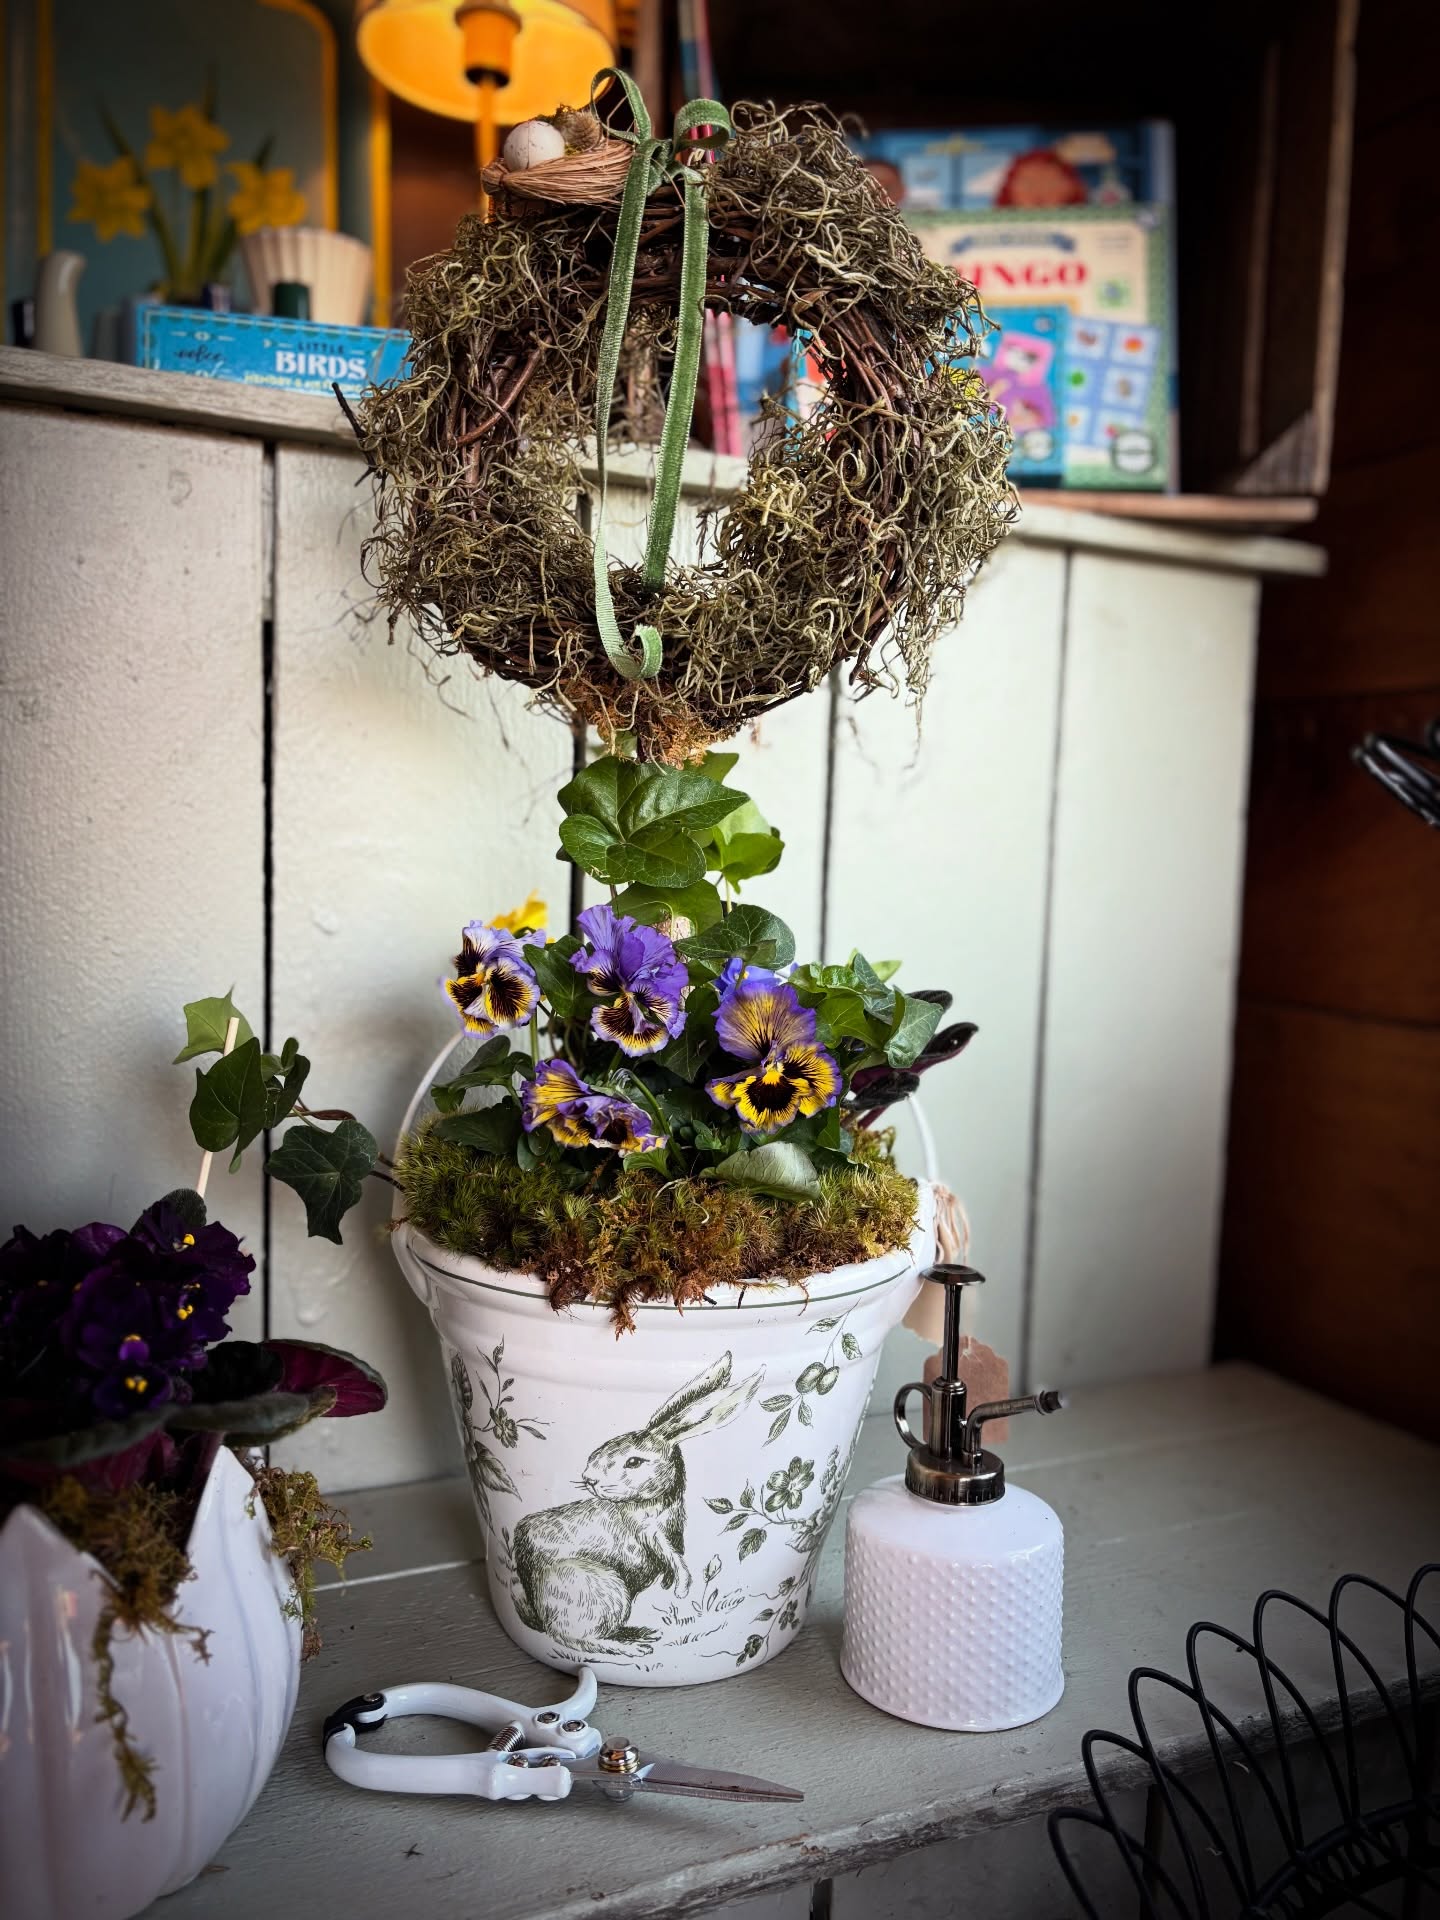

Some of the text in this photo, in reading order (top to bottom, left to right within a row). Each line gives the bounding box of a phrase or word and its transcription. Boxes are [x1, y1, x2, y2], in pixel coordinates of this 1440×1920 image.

[954, 261, 1087, 289] INGO
[297, 341, 345, 354] LITTLE
[275, 350, 367, 380] BIRDS
